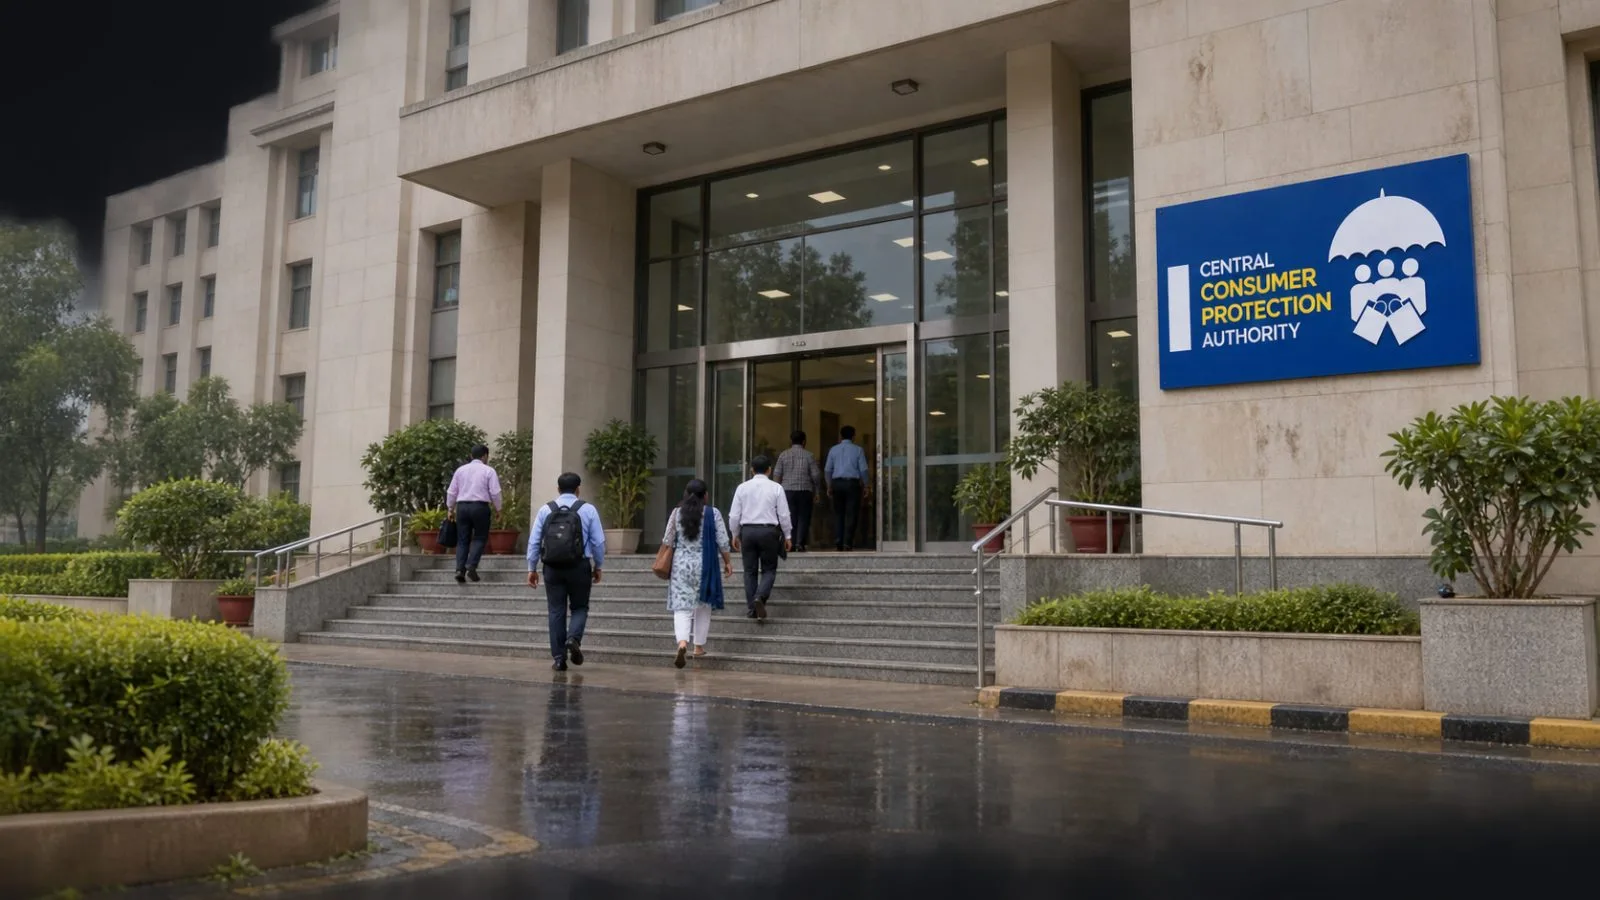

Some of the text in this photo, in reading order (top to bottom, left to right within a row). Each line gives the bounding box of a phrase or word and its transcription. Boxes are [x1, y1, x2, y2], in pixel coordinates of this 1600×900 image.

[1200, 252, 1275, 278] CENTRAL
[1200, 267, 1317, 302] CONSUMER
[1201, 292, 1332, 326] PROTECTION
[1202, 322, 1300, 349] AUTHORITY
